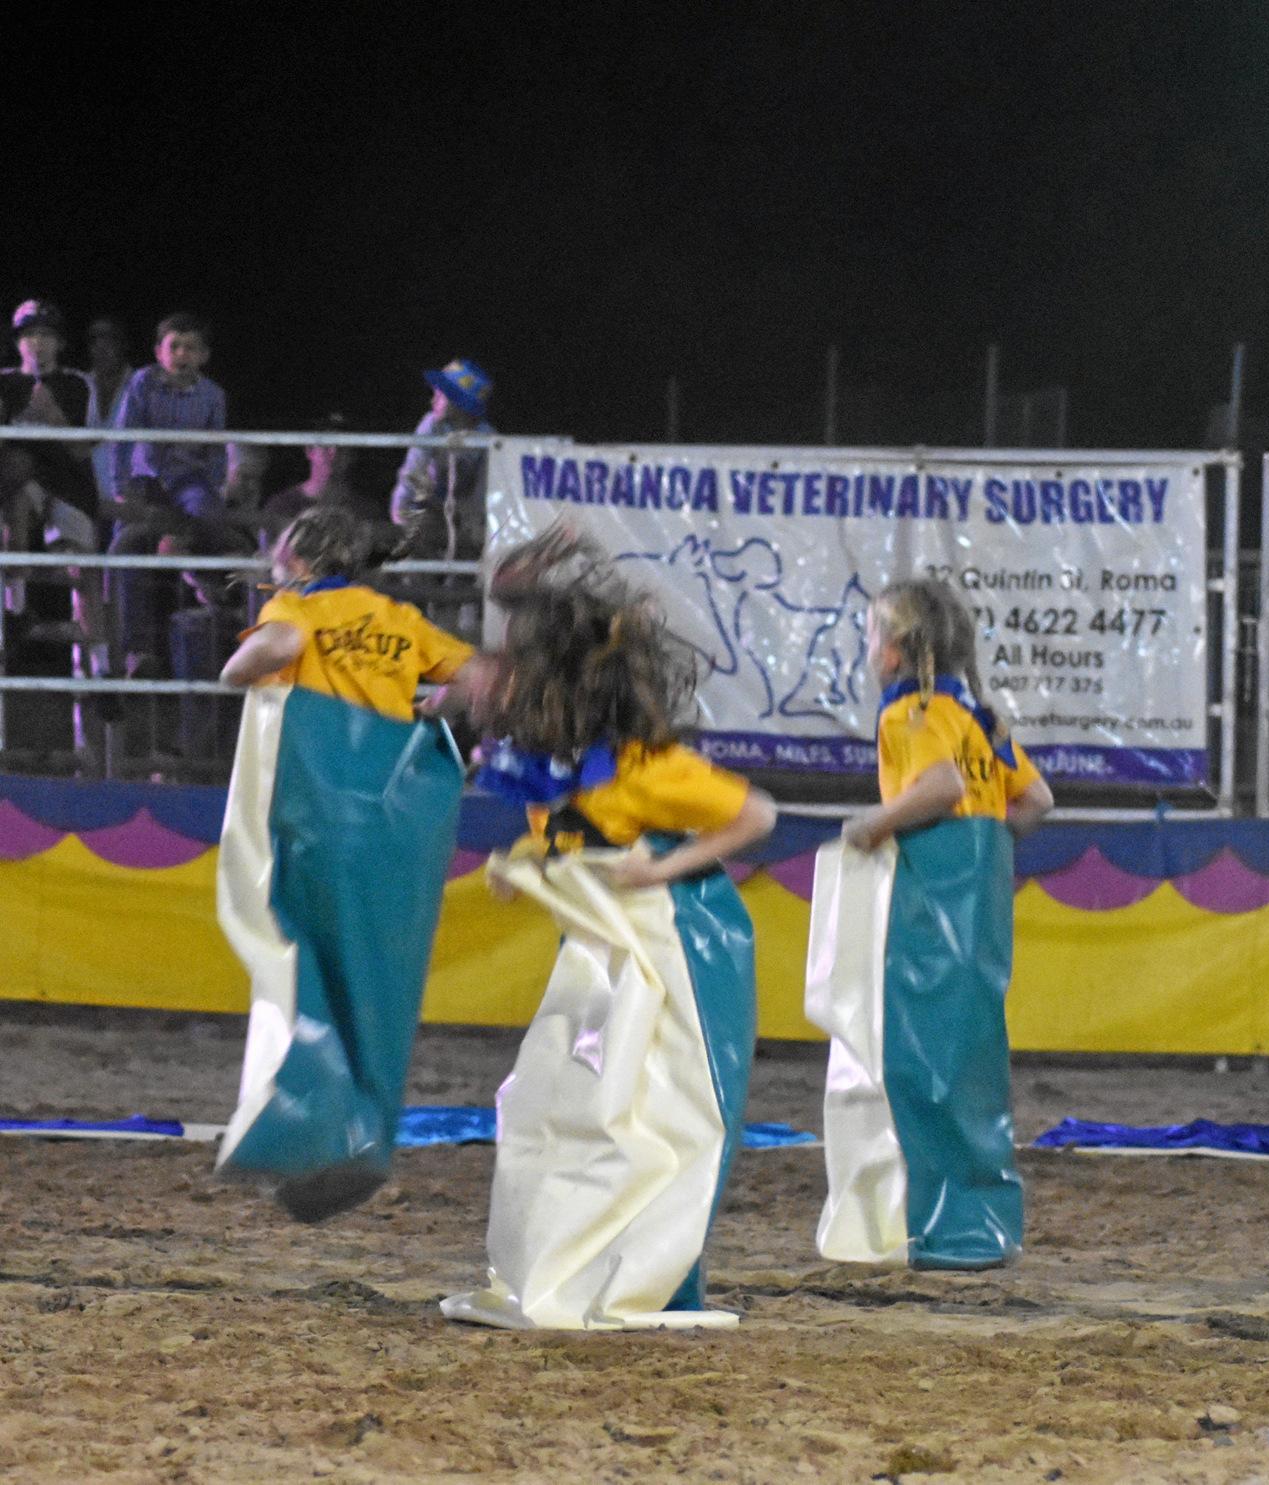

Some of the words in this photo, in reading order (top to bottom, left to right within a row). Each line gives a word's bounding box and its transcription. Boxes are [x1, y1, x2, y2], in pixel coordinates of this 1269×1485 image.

[520, 455, 719, 514] MARANOA
[730, 470, 972, 521] VETERINARY
[984, 477, 1168, 525] SURGERY
[1101, 571, 1177, 591] Roma
[1005, 607, 1078, 634] 4622
[1089, 610, 1166, 636] 4477
[992, 643, 1022, 665] All
[1030, 645, 1104, 668] Hours
